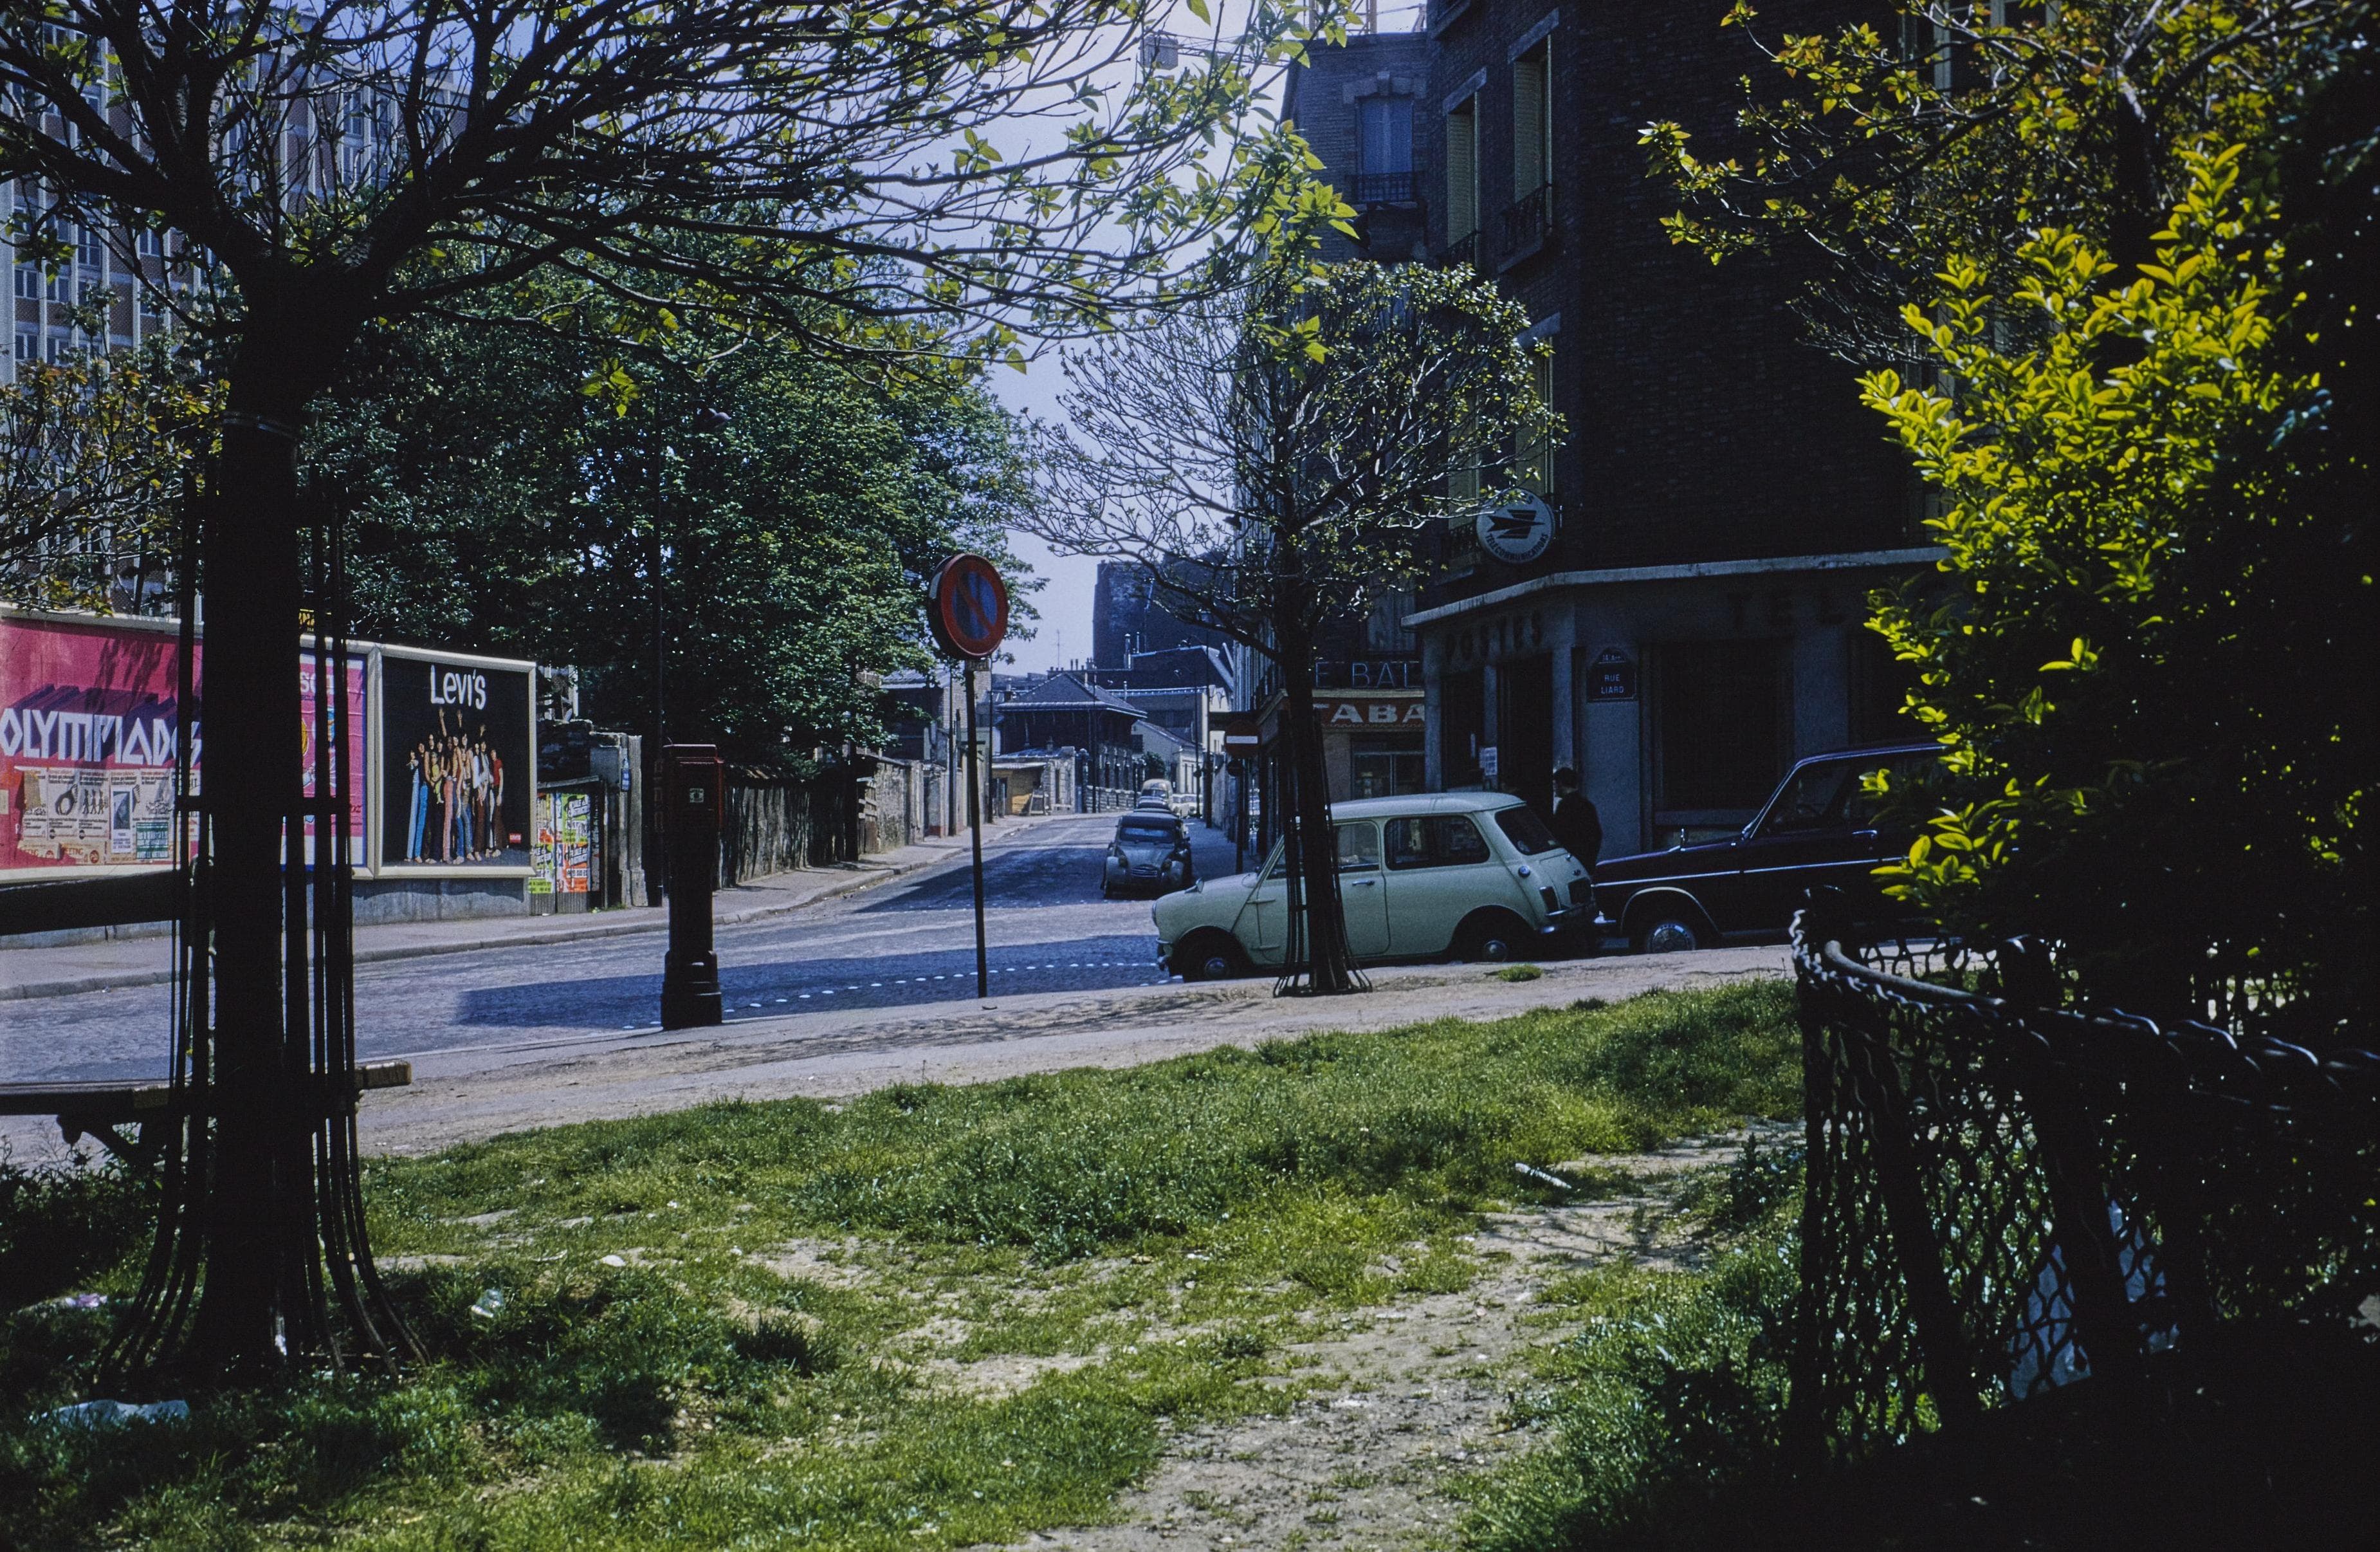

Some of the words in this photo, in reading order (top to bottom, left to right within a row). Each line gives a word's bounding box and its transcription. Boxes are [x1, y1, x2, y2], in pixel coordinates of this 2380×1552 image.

[430, 664, 486, 710] Levi's
[1600, 685, 1625, 695] LIARD
[1604, 674, 1621, 683] RUE
[0, 708, 202, 768] OLYMPIADS
